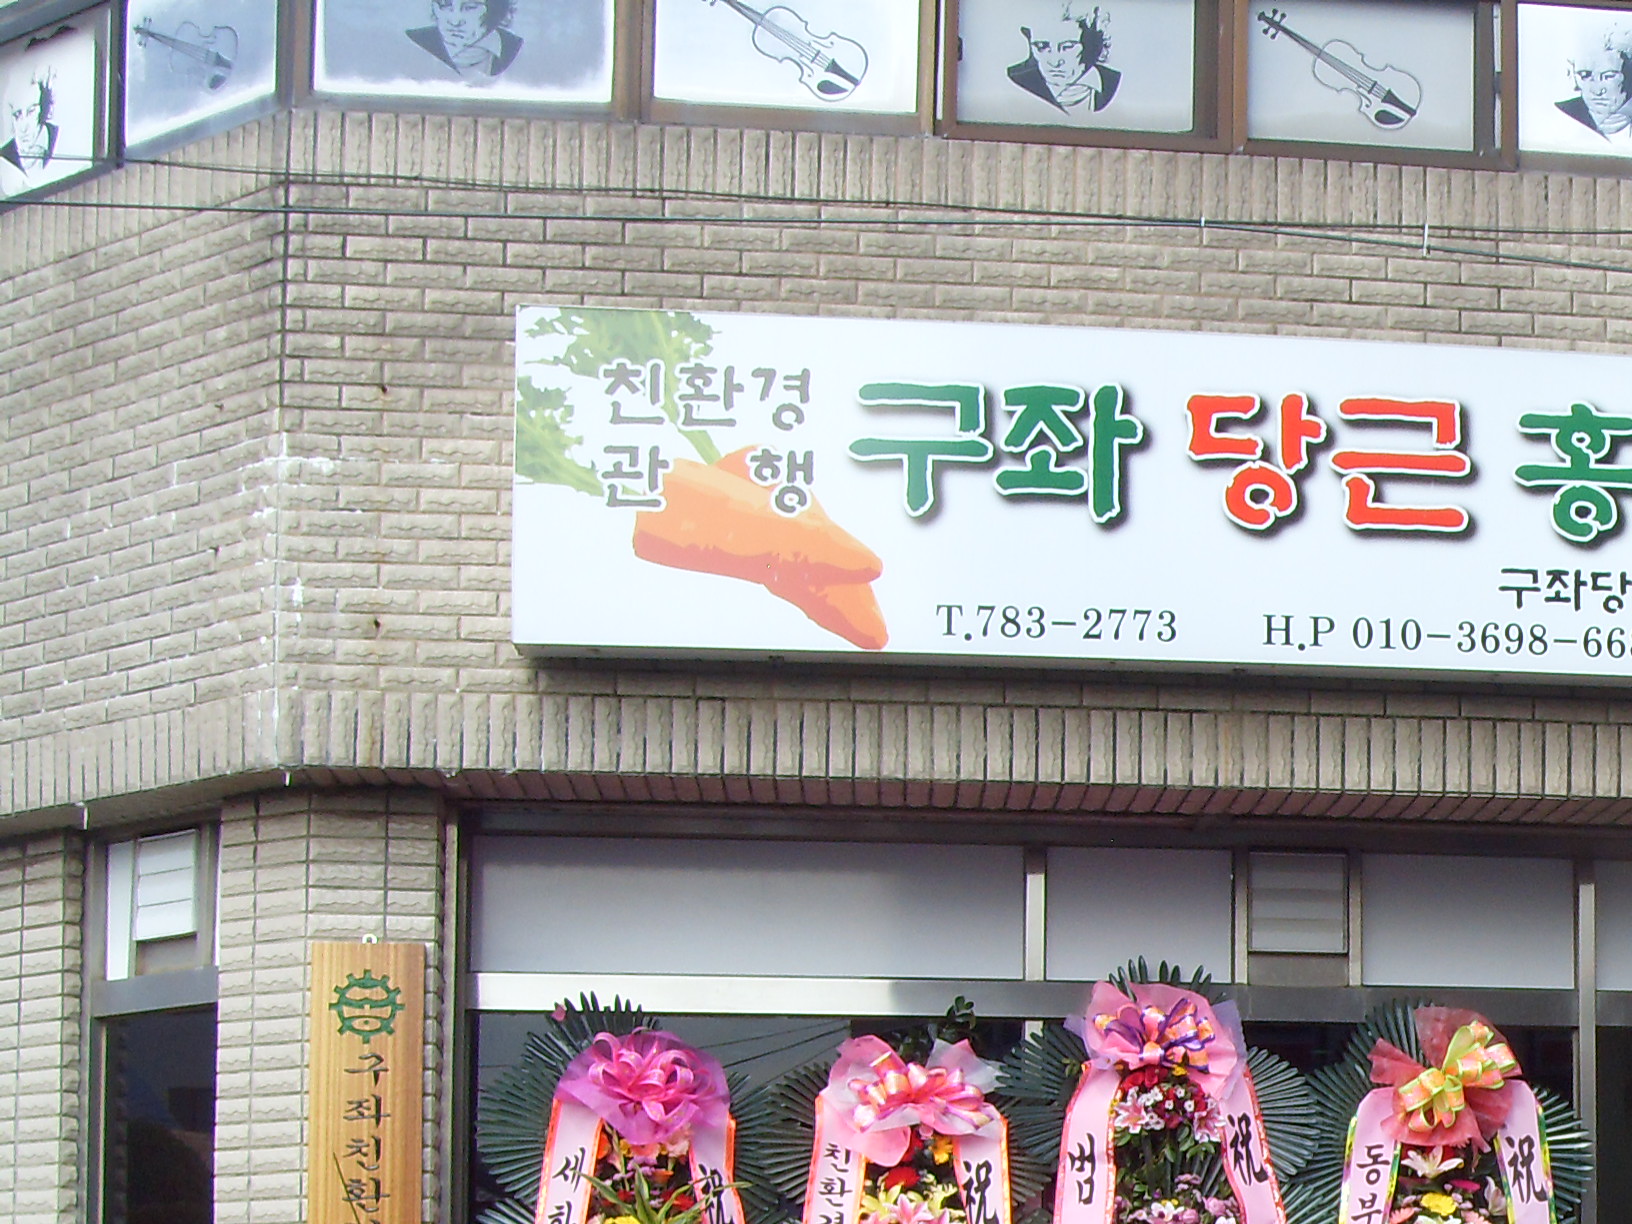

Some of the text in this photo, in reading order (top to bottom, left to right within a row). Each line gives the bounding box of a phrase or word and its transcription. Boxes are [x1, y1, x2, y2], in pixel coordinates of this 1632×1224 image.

[602, 362, 811, 432] 친환경
[601, 445, 814, 515] 관 행
[849, 380, 1142, 523] 구좌
[1186, 391, 1472, 533] 당근
[935, 603, 1178, 643] T.783-2773
[1262, 614, 1336, 652] H.P
[1227, 1112, 1269, 1186] 祝
[1505, 1134, 1548, 1204] 祝
